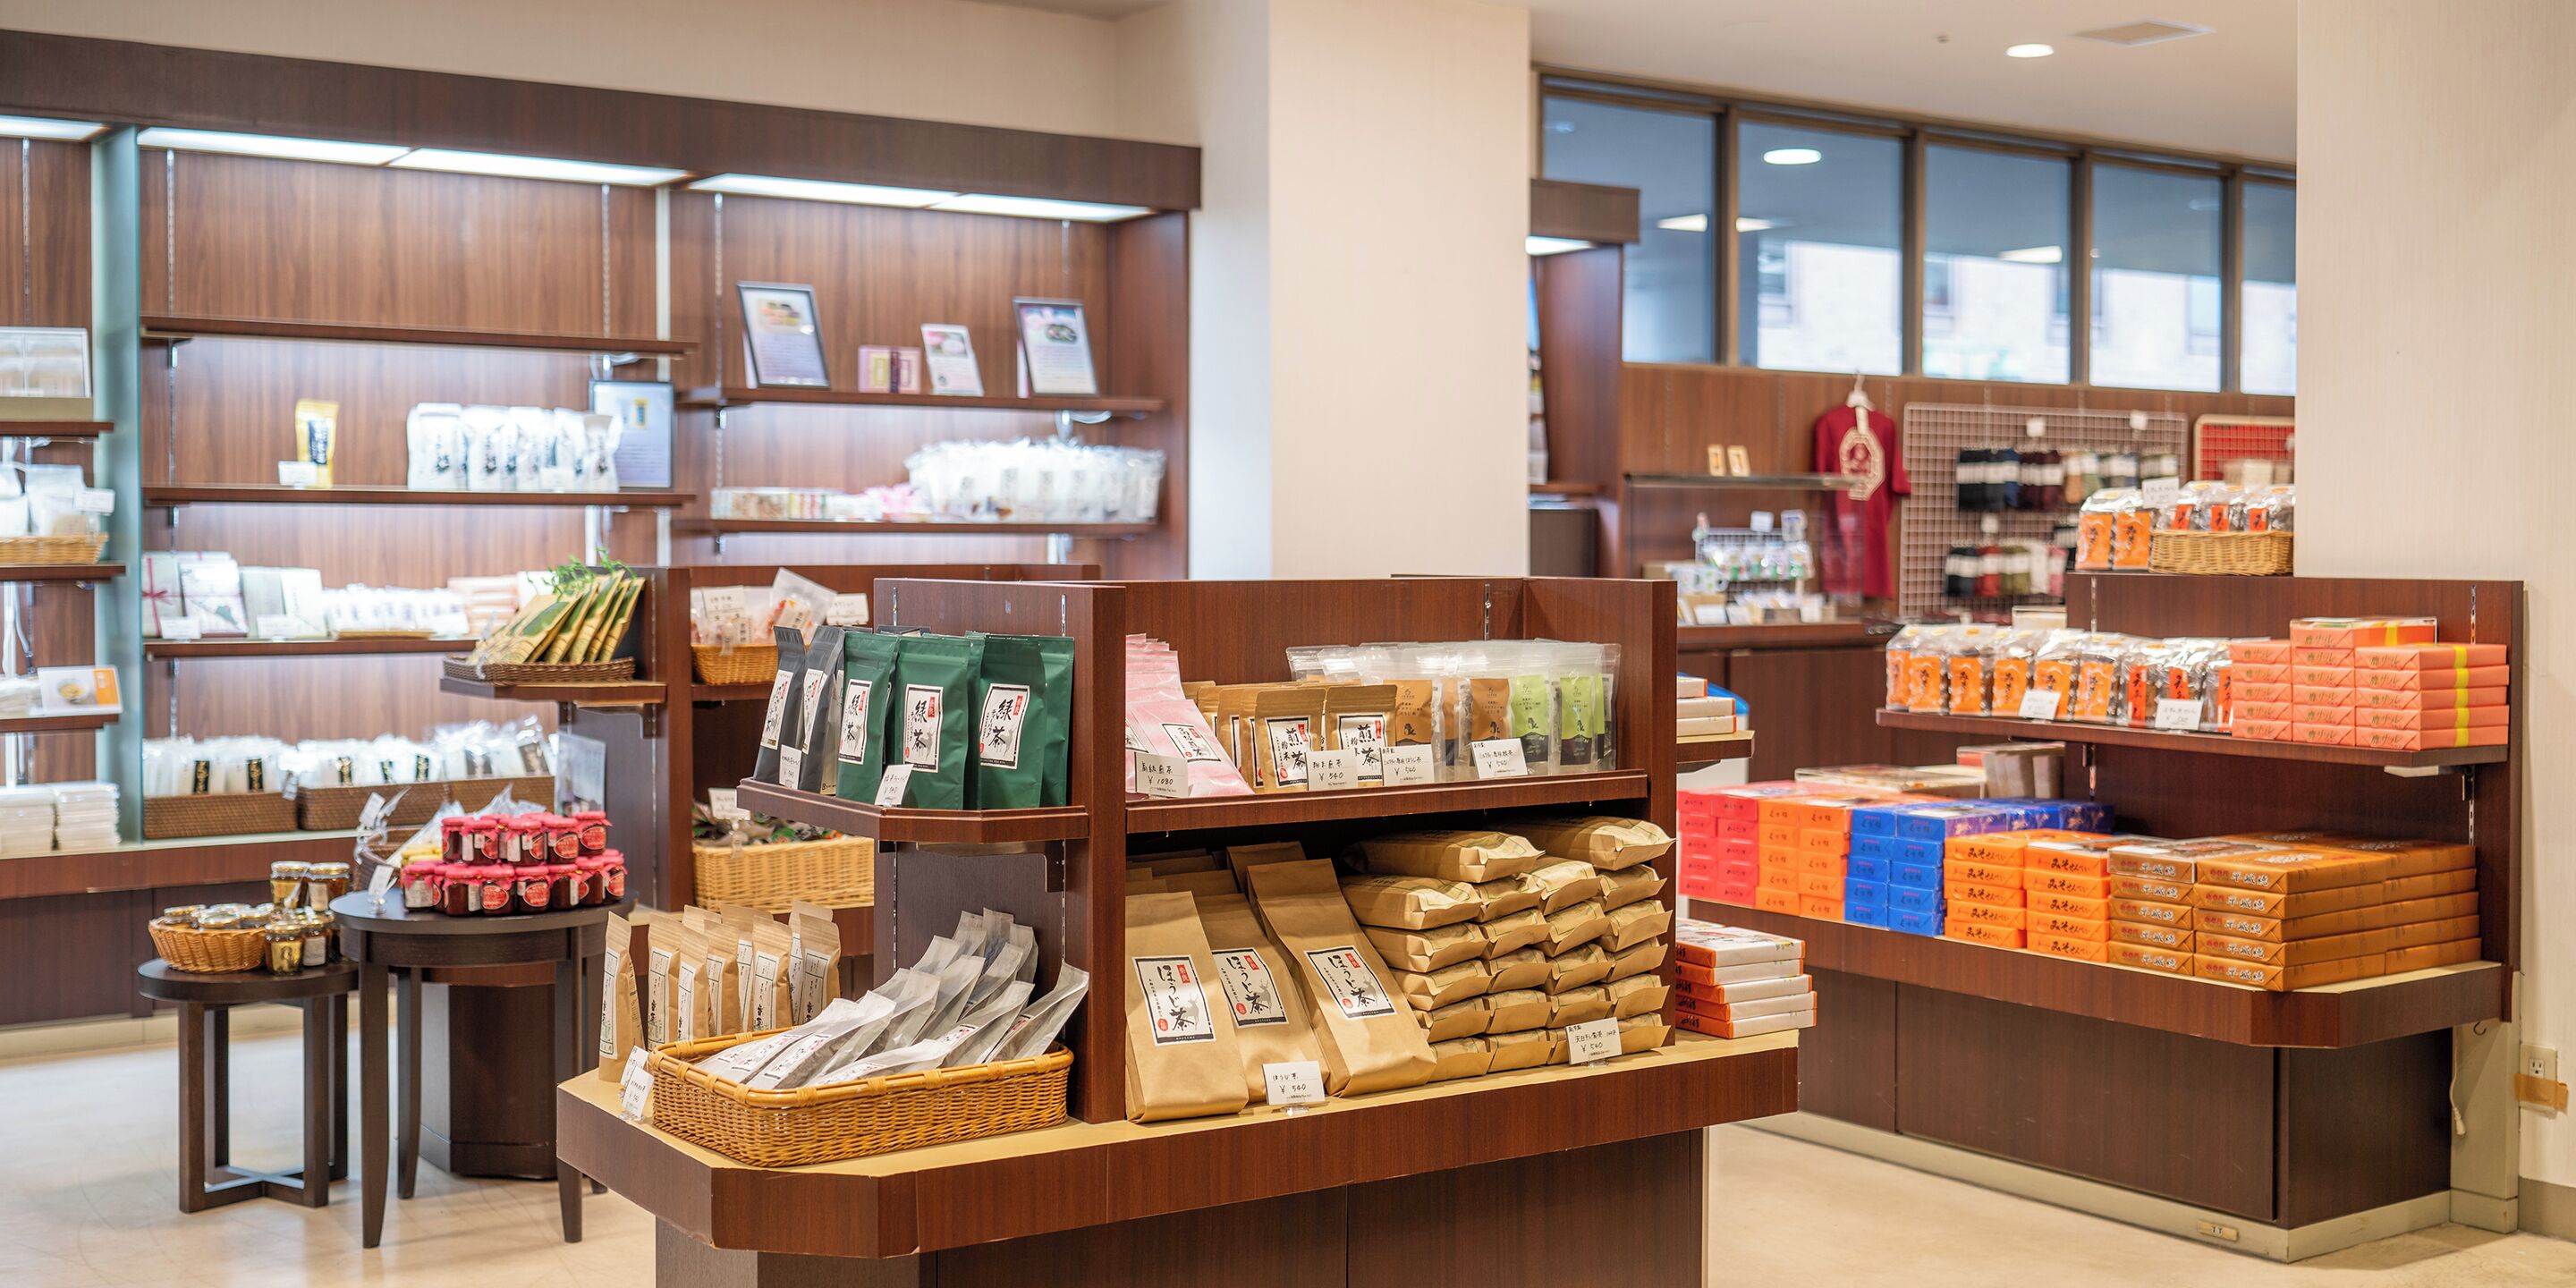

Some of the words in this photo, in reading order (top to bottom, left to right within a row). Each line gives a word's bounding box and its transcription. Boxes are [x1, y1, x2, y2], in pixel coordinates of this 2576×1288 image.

[912, 699, 927, 750] 緑茶
[988, 699, 1013, 748] 緑茶
[1282, 741, 1290, 761] 粉末
[1286, 728, 1306, 769] 煎茶
[1358, 724, 1378, 766] 煎茶
[1968, 848, 2006, 860] みそせんべい
[2051, 858, 2089, 871] みそせんべい
[1968, 869, 2004, 881] みそせんべい
[2047, 878, 2088, 893] みそせんべい
[1968, 888, 2005, 901] みそせんべい
[2050, 899, 2090, 913] みそせんべい
[1970, 908, 2010, 921] みそせんべい
[1966, 927, 2002, 940] みそせんべい
[2050, 919, 2090, 934] みそせんべい
[2051, 941, 2091, 954] みそせんべい
[1244, 955, 1259, 970] 奈良
[1178, 965, 1190, 983] 奈良
[1327, 955, 1375, 1007] ほうじ茶
[1226, 956, 1268, 1014] ほうじ茶
[1157, 964, 1194, 1031] ほうじ茶
